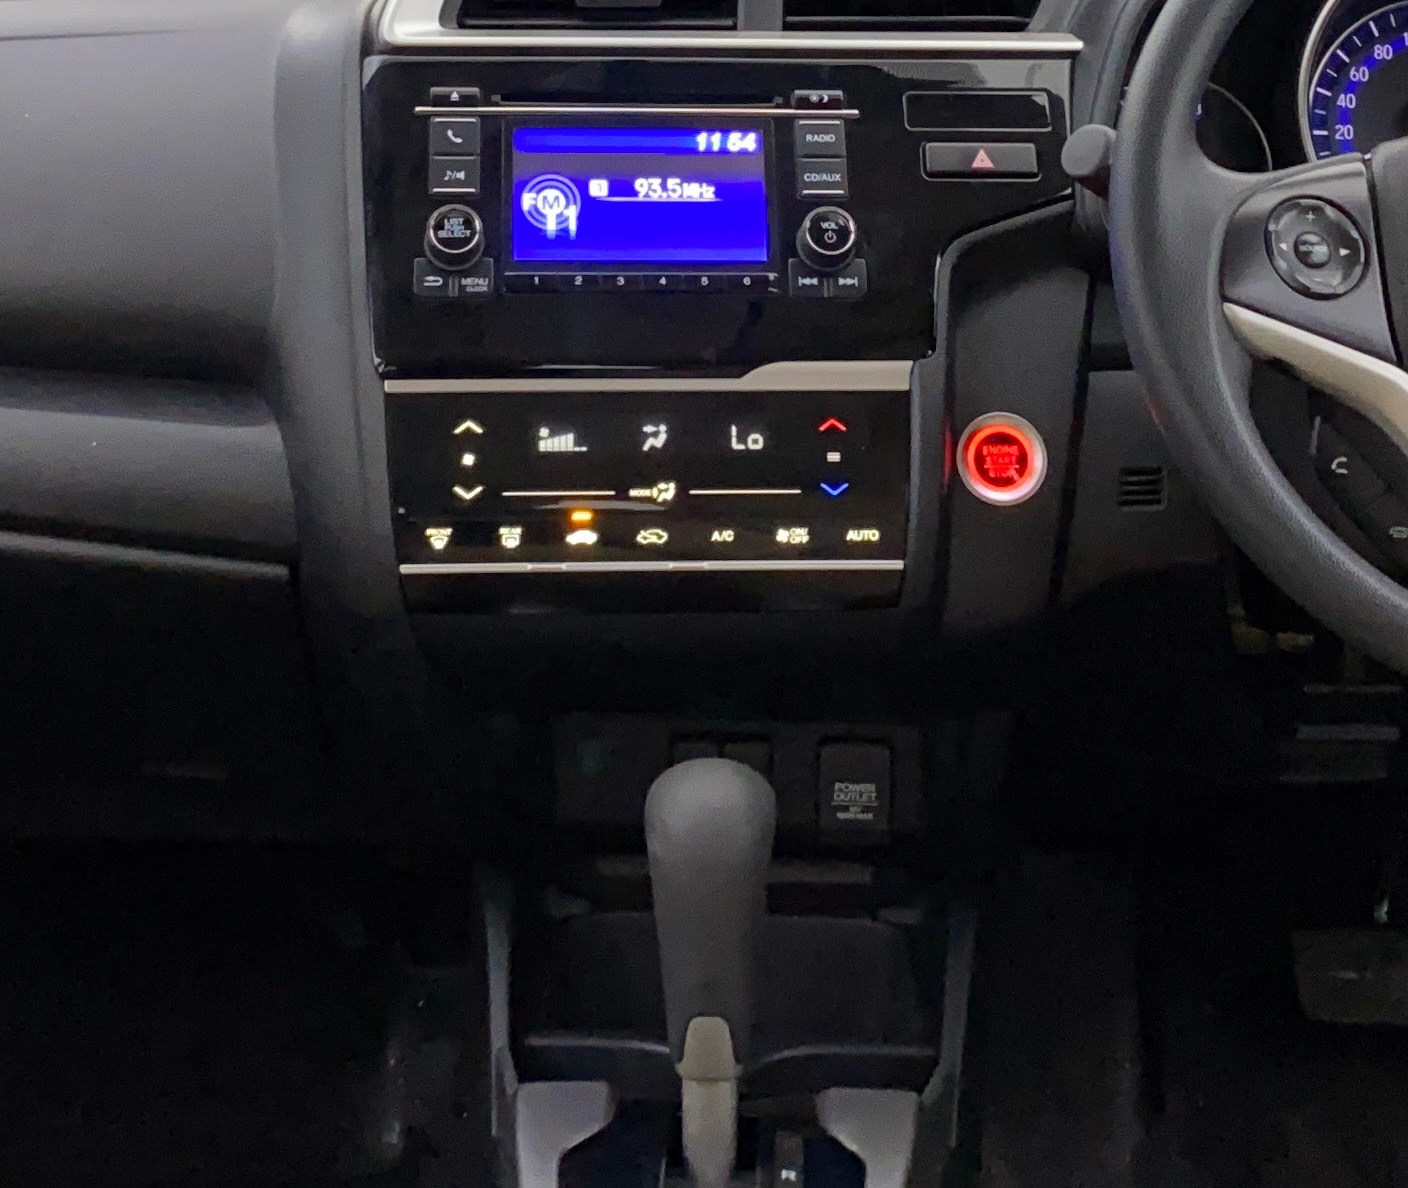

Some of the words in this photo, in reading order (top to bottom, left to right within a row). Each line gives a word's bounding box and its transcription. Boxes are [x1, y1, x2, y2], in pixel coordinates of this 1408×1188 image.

[1374, 45, 1393, 60] 80
[1349, 67, 1369, 82] 60
[1336, 93, 1356, 108] 40
[805, 133, 836, 142] RADIO
[1334, 125, 1354, 140] 20
[803, 172, 842, 182] CD/AUX
[820, 221, 838, 230] VOL
[437, 229, 471, 238] SELECT
[461, 277, 489, 286] MENU
[533, 276, 539, 286] 1
[574, 276, 583, 286] 2
[617, 276, 625, 286] 3
[659, 276, 667, 286] 4
[701, 276, 709, 286] 5
[743, 276, 751, 286] 6
[730, 423, 764, 450] Lo
[629, 488, 652, 498] MODE
[711, 529, 735, 542] A/C
[846, 529, 880, 542] AUTO
[834, 782, 876, 793] POWER
[833, 792, 878, 802] OUTLET
